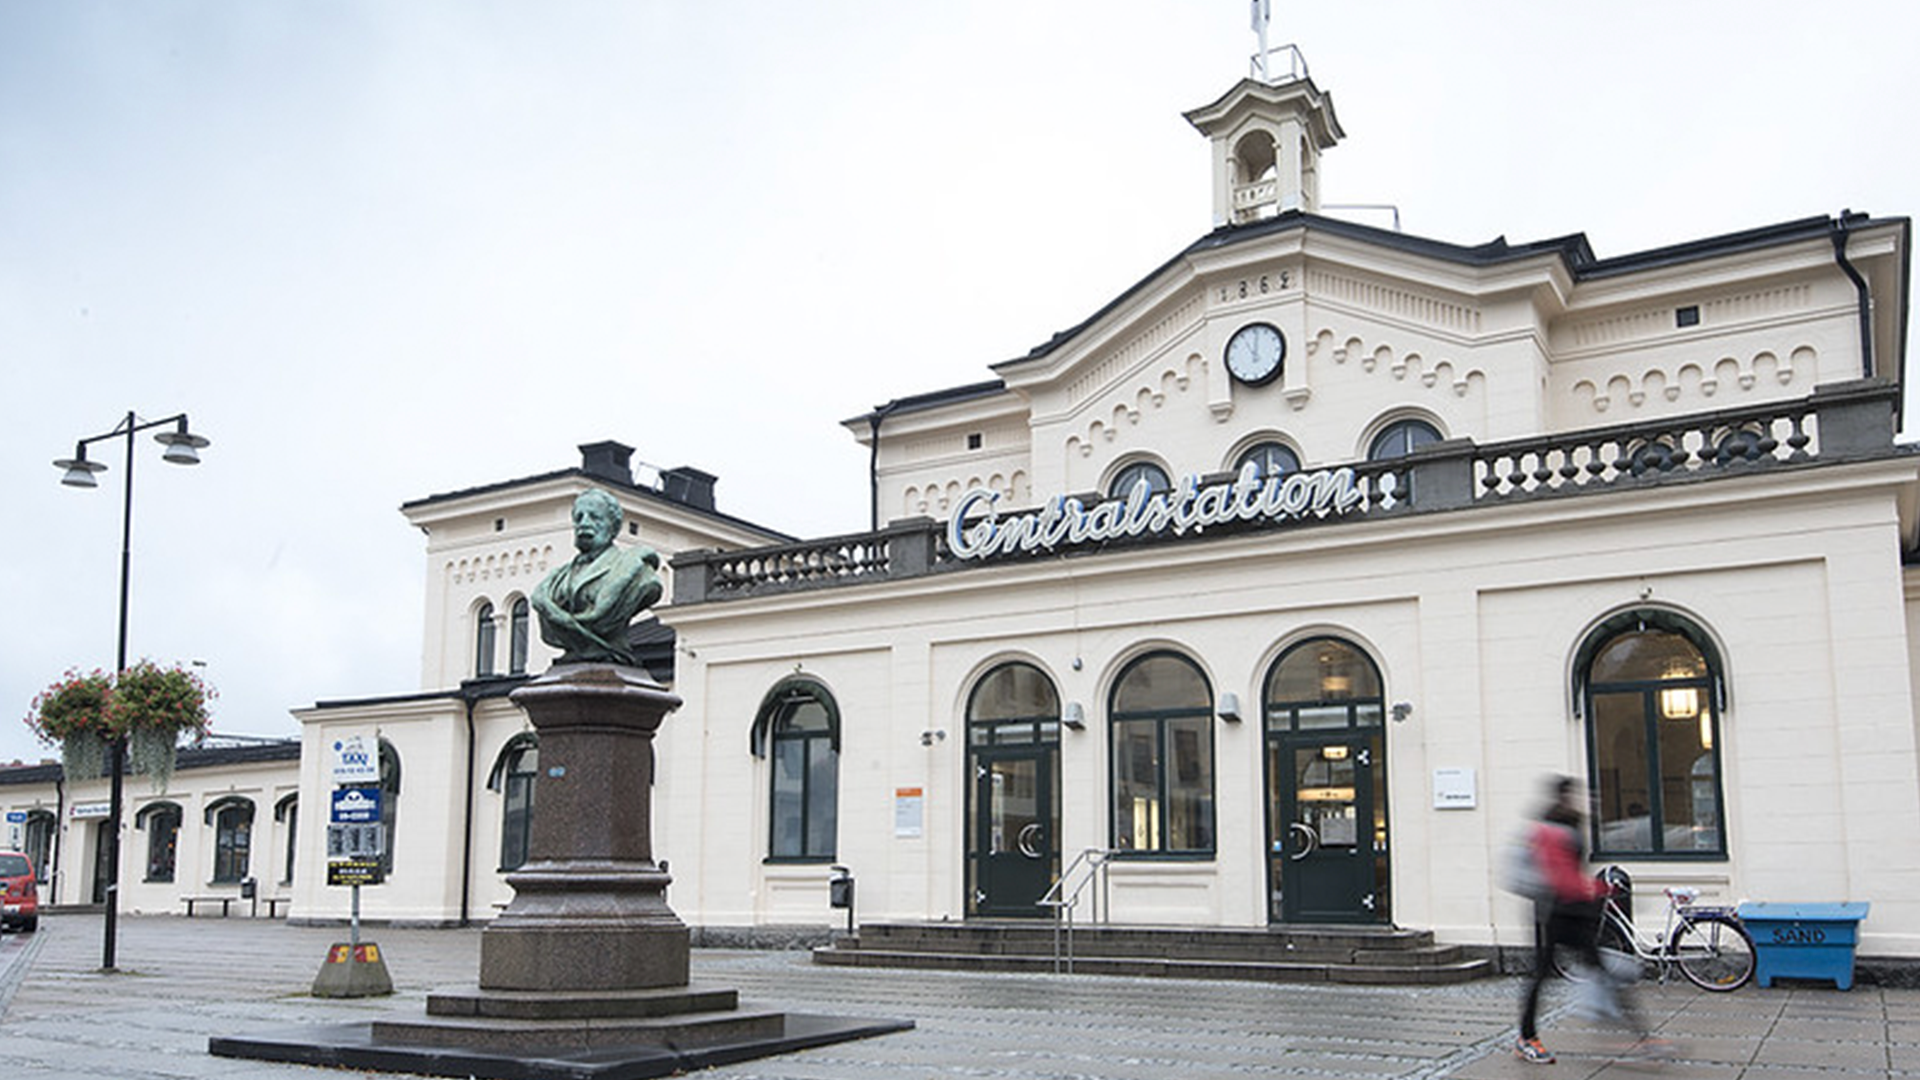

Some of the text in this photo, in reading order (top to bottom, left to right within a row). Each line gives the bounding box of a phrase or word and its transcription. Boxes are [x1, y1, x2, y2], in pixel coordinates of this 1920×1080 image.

[1221, 270, 1289, 301] 1862
[947, 461, 1362, 558] Centralstation
[1772, 929, 1826, 944] SAND
